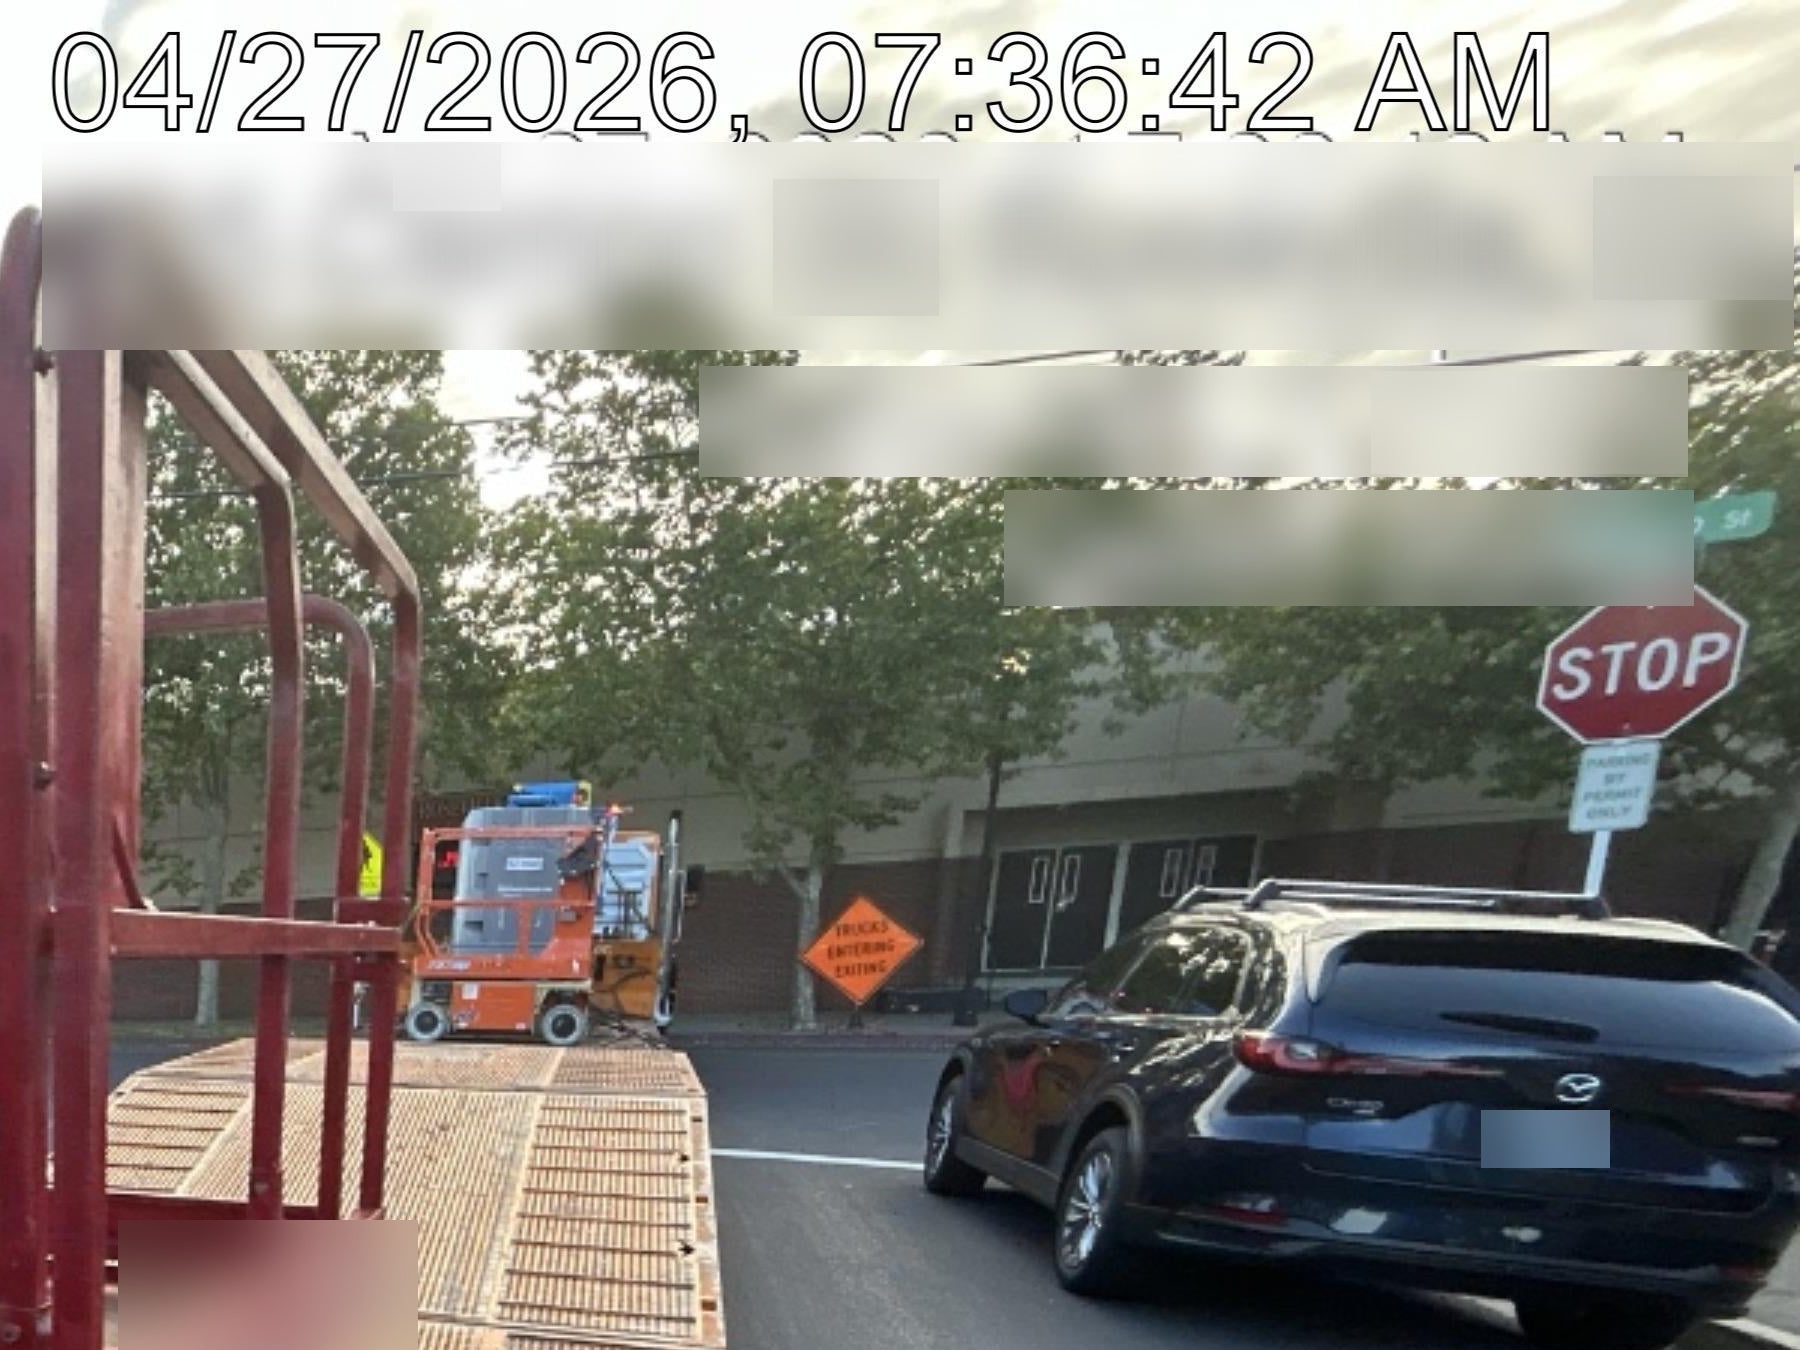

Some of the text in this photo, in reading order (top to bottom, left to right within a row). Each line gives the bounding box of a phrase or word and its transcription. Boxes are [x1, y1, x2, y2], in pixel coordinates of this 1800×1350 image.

[1723, 507, 1751, 530] St
[1552, 632, 1731, 701] STOP
[836, 920, 890, 937] TRUCKS
[827, 938, 896, 961] ENTERING
[835, 959, 888, 979] EXITING
